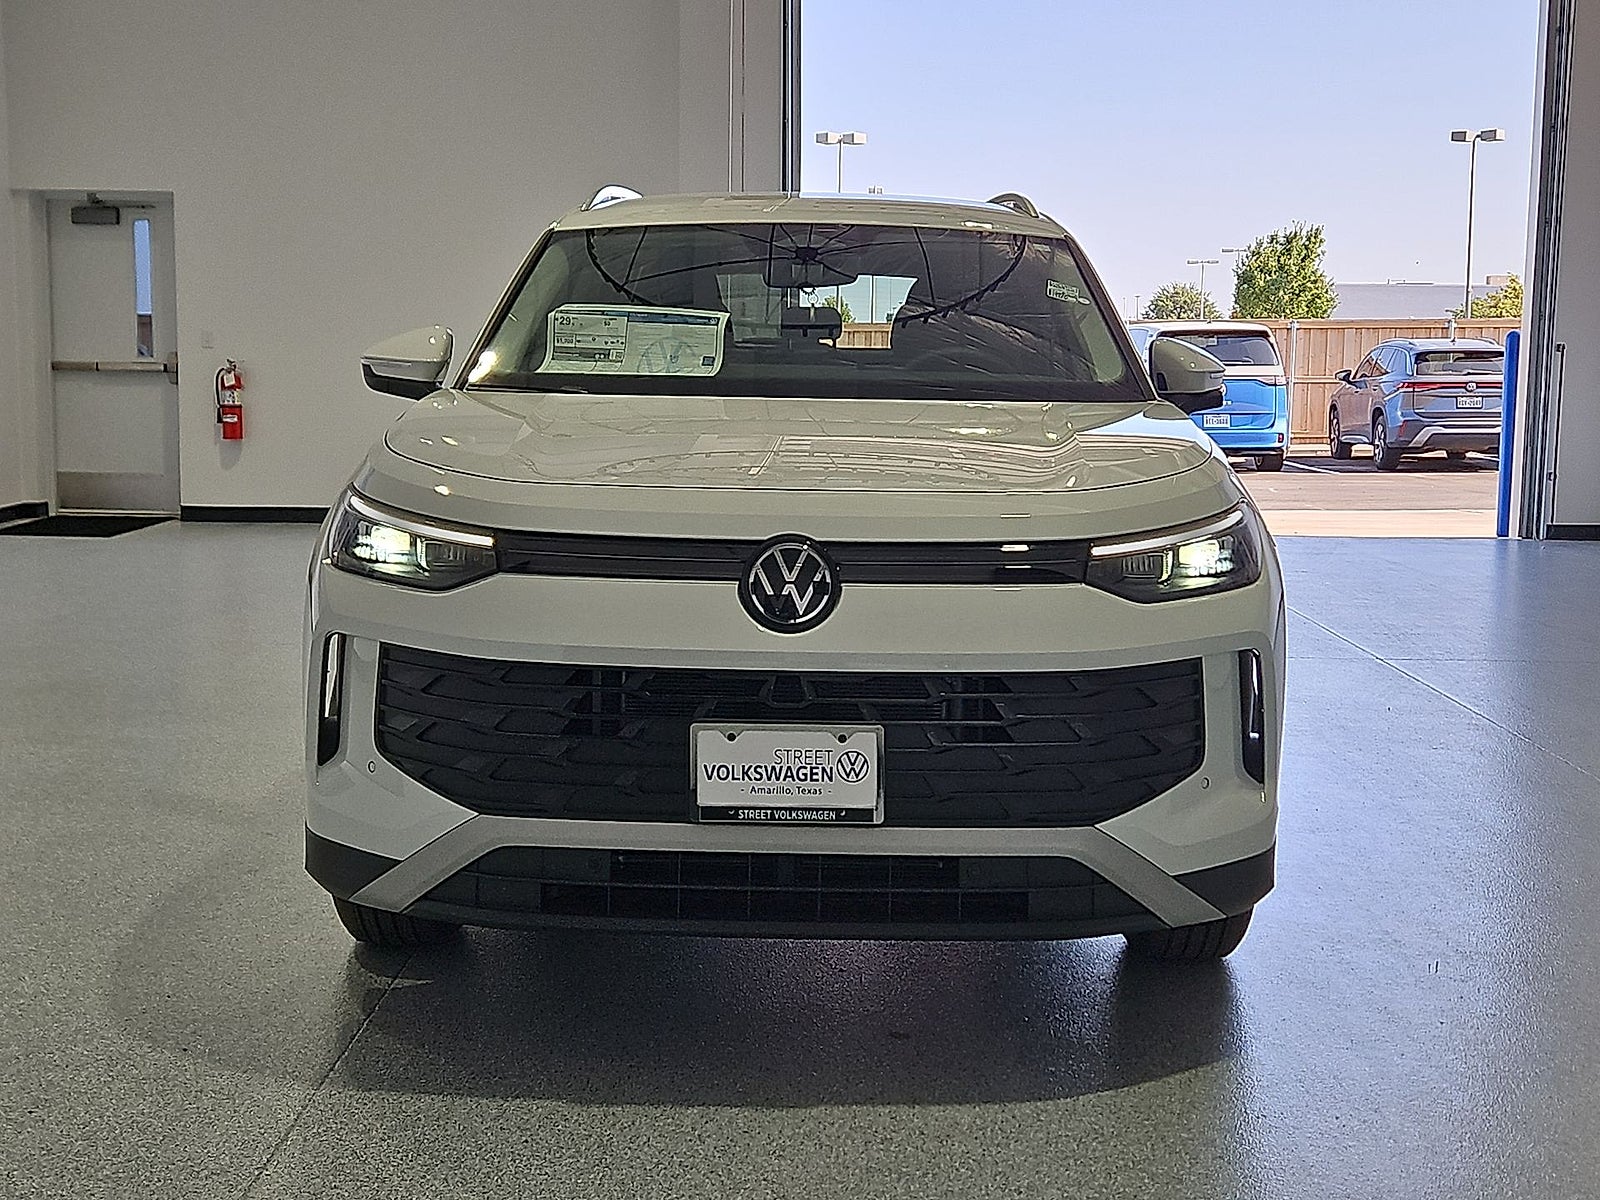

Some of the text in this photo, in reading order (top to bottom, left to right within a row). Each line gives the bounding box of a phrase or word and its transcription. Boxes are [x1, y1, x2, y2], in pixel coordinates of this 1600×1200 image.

[559, 316, 571, 326] 29
[774, 749, 833, 765] STREET
[703, 764, 833, 782] VOLKSWAGEN
[837, 750, 869, 783] VW
[749, 786, 823, 796] Amarillo, Texas
[738, 810, 836, 820] STREET VOLKSWAGEN
